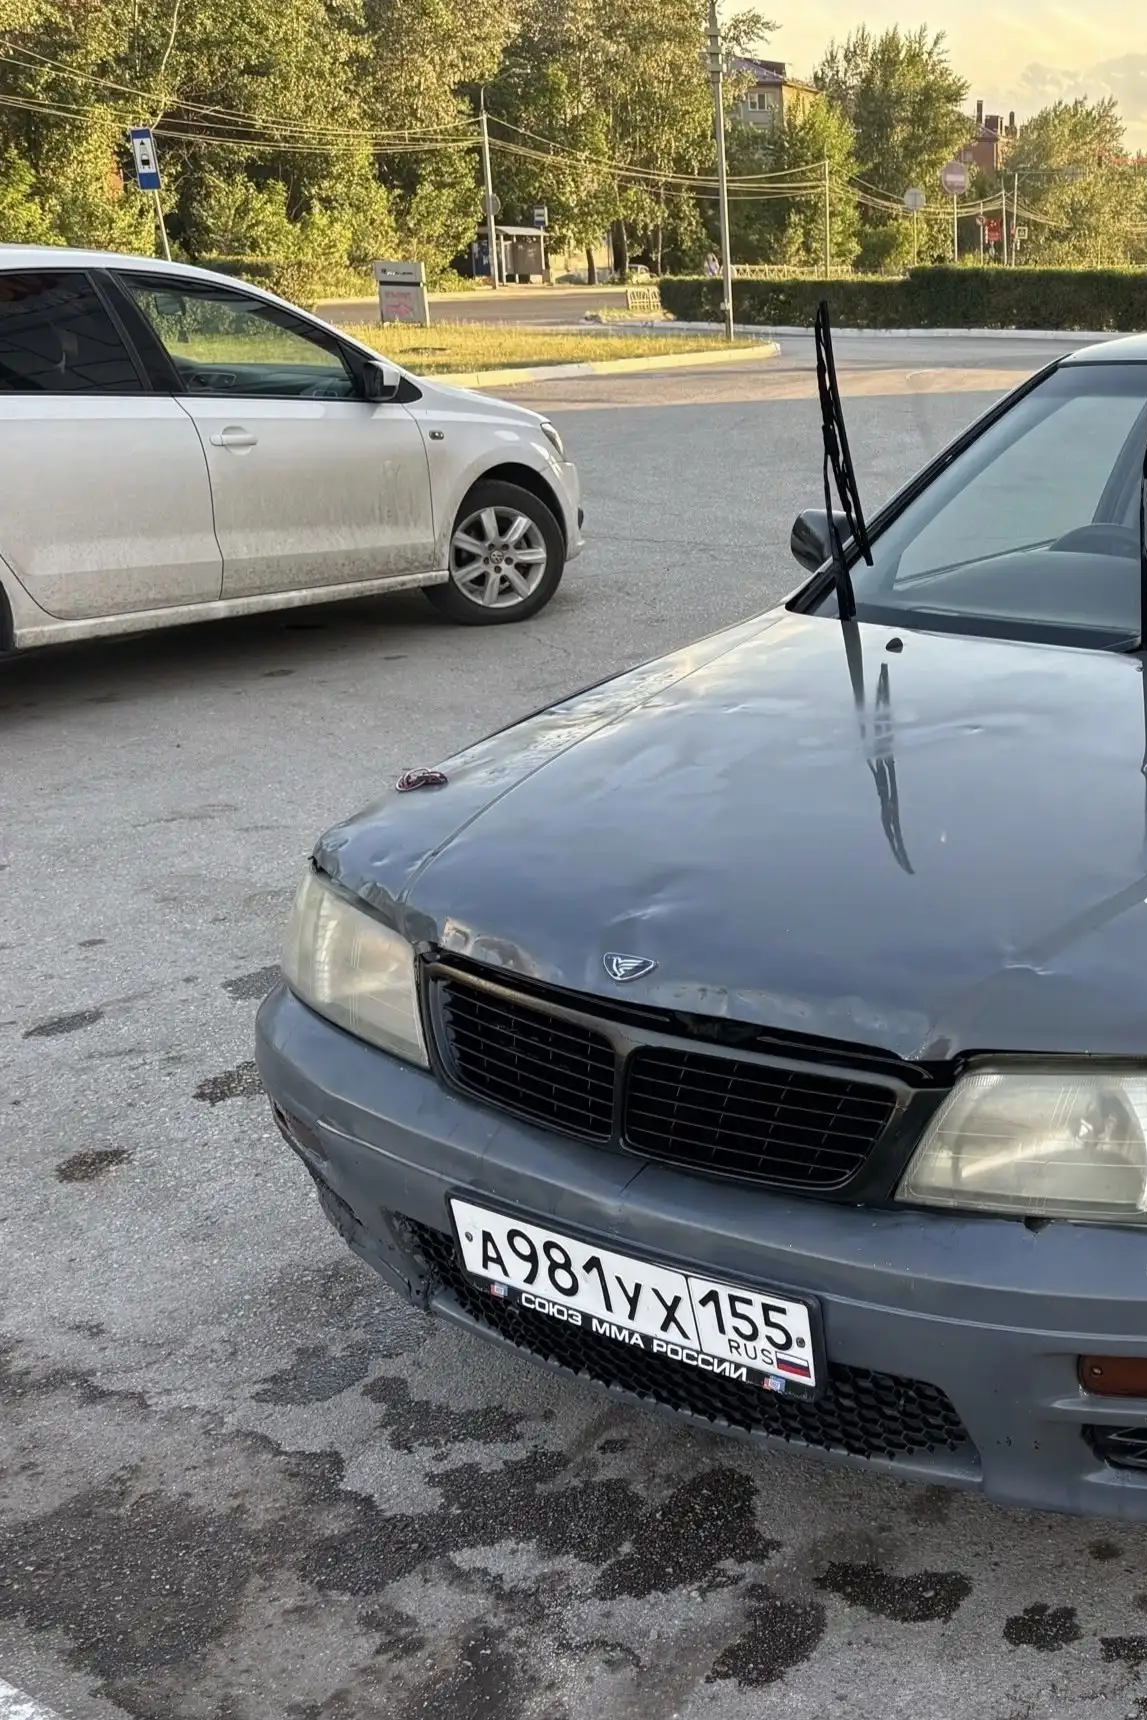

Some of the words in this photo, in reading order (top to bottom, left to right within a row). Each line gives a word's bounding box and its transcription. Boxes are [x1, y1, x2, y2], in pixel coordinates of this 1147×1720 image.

[481, 1229, 691, 1340] А981УХ
[698, 1289, 793, 1351] 155
[520, 1291, 582, 1326] СОЮЗ
[592, 1318, 645, 1350] ММА
[652, 1338, 748, 1382] РОССИИ
[728, 1337, 774, 1366] RUS
